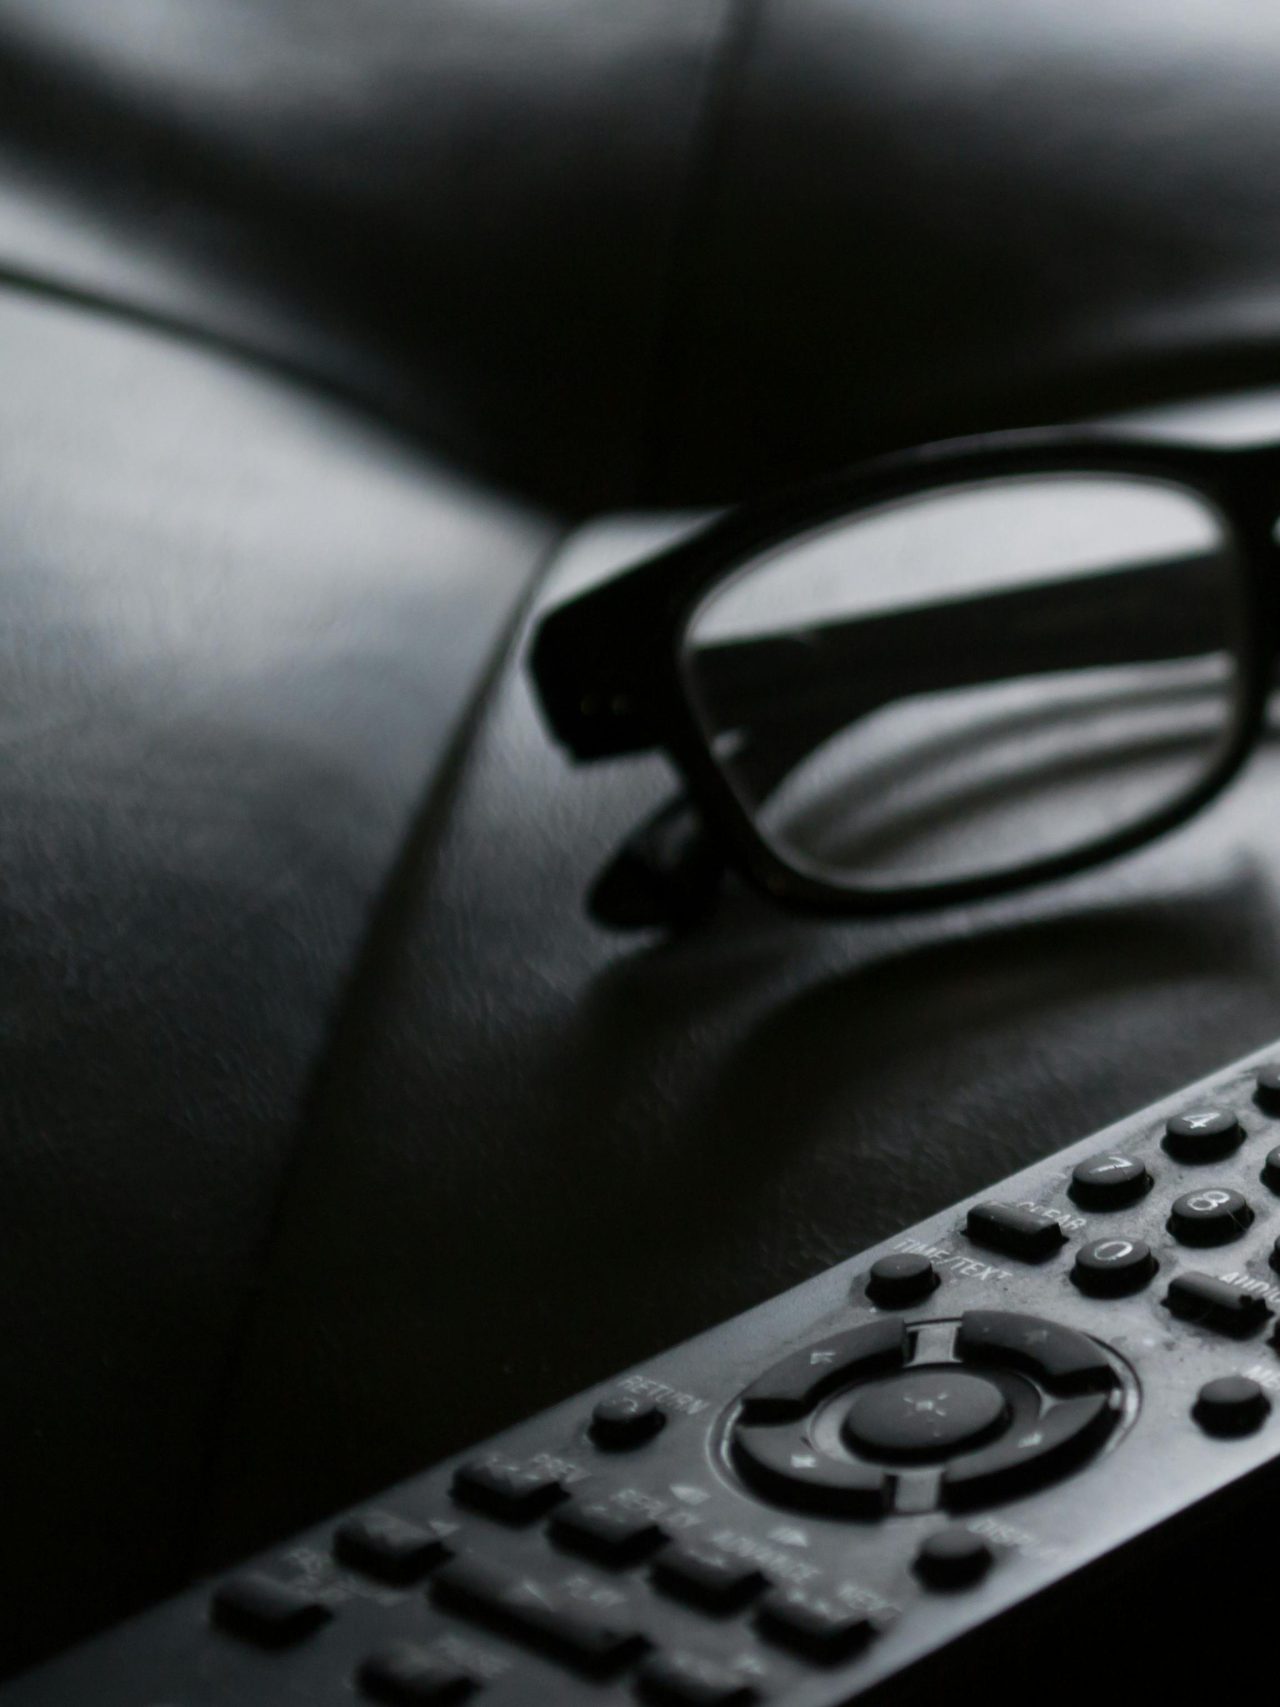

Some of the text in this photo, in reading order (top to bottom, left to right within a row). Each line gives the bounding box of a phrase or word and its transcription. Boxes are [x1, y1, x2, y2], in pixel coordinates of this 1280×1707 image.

[1182, 1112, 1221, 1129] 4
[1089, 1156, 1134, 1175] 7
[1187, 1190, 1230, 1211] 8
[893, 1238, 1014, 1281] TIME/TEXT
[1093, 1240, 1133, 1261] 0
